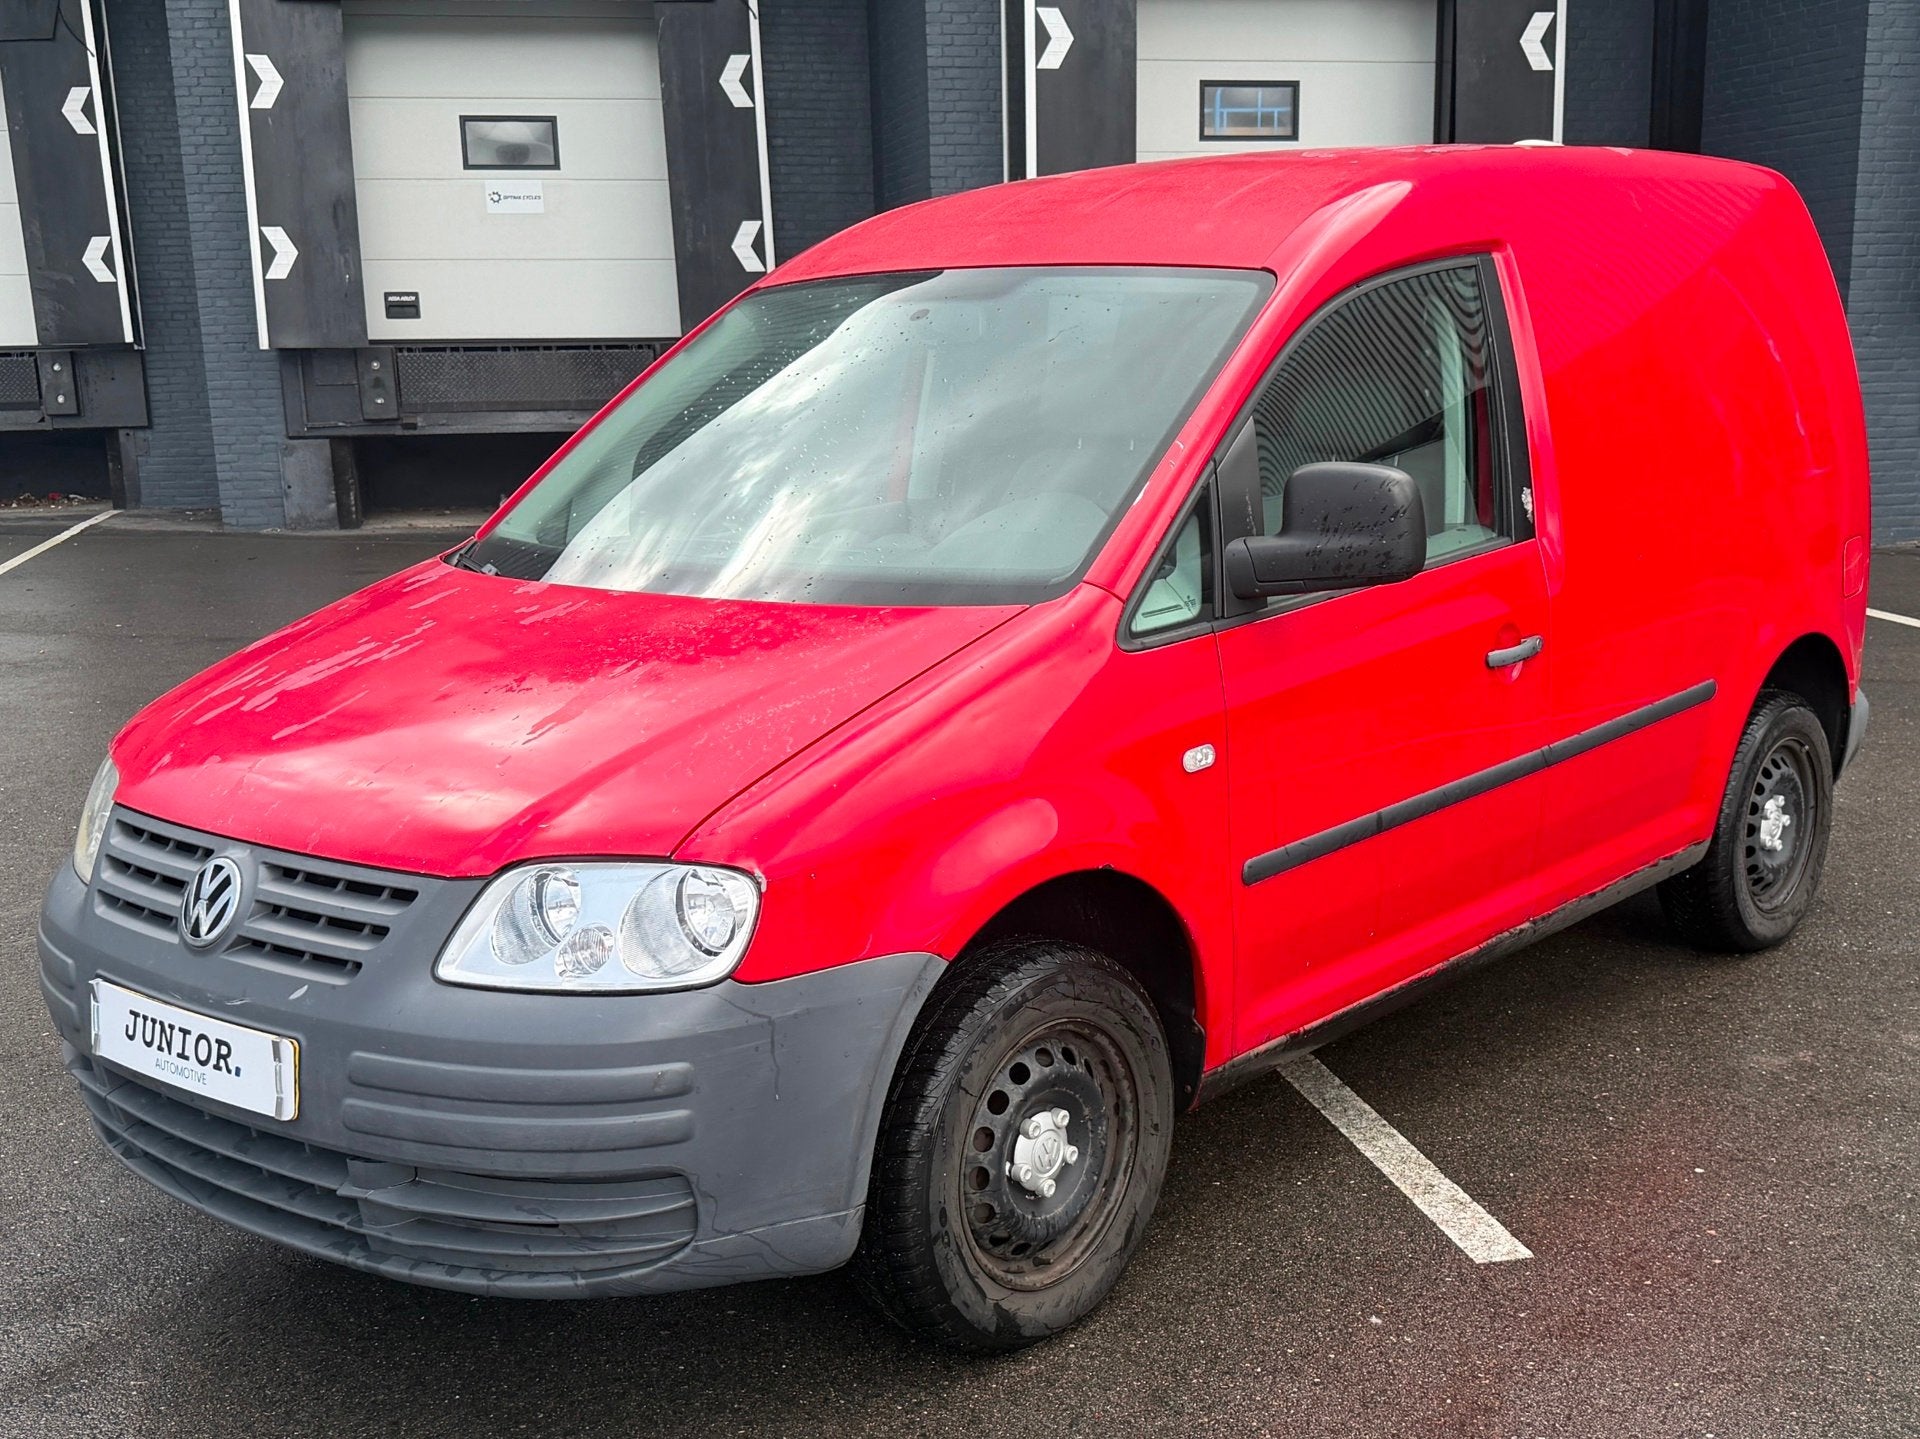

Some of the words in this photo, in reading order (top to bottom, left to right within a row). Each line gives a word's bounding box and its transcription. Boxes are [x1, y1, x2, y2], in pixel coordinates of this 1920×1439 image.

[185, 859, 239, 943] VW
[125, 1009, 241, 1077] JUNIOR.
[155, 1057, 207, 1086] AUTOMOTIVE
